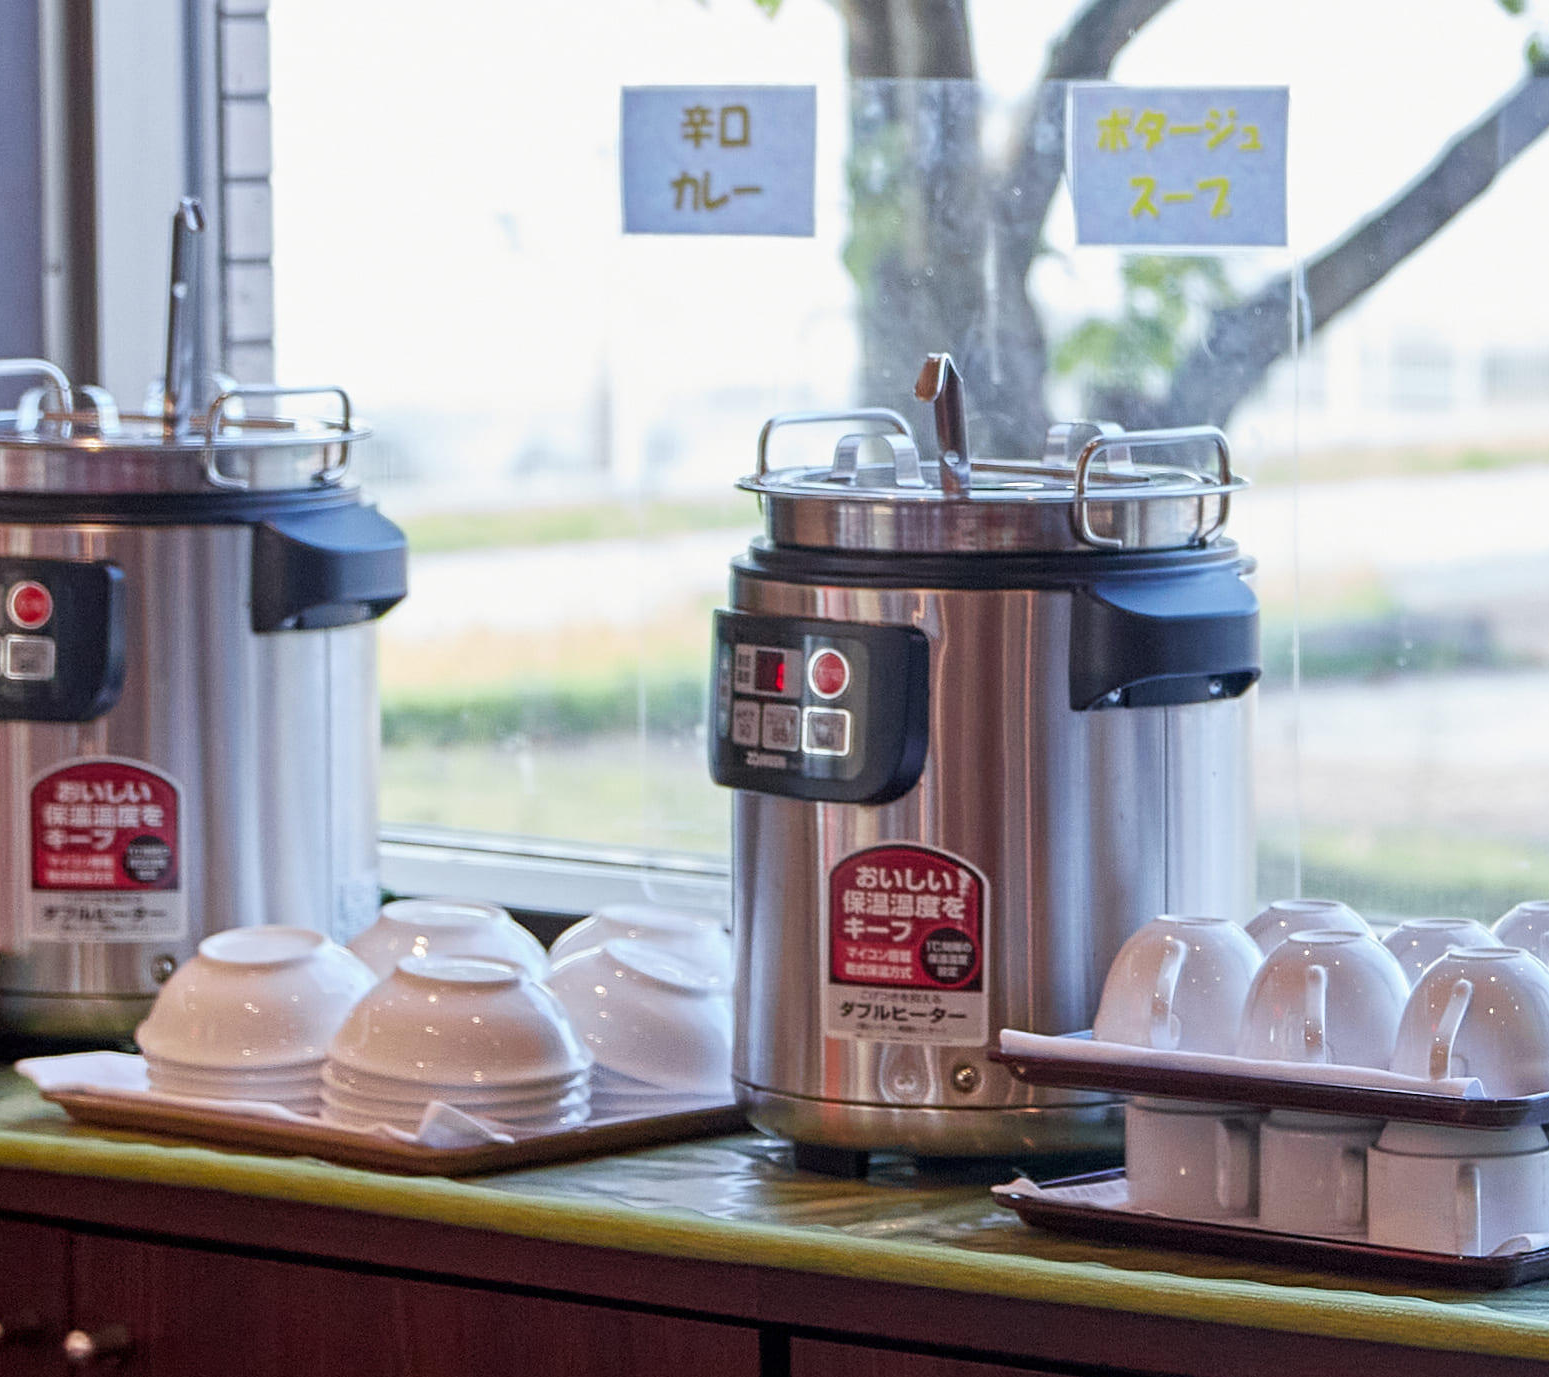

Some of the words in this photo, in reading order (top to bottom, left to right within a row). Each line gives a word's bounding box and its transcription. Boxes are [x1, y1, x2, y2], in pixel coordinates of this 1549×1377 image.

[681, 105, 751, 149] 辛口
[1097, 108, 1262, 151] ポタージュ
[670, 171, 763, 211] カレー
[856, 866, 953, 892] おいしい
[843, 889, 966, 920] 保温温度を
